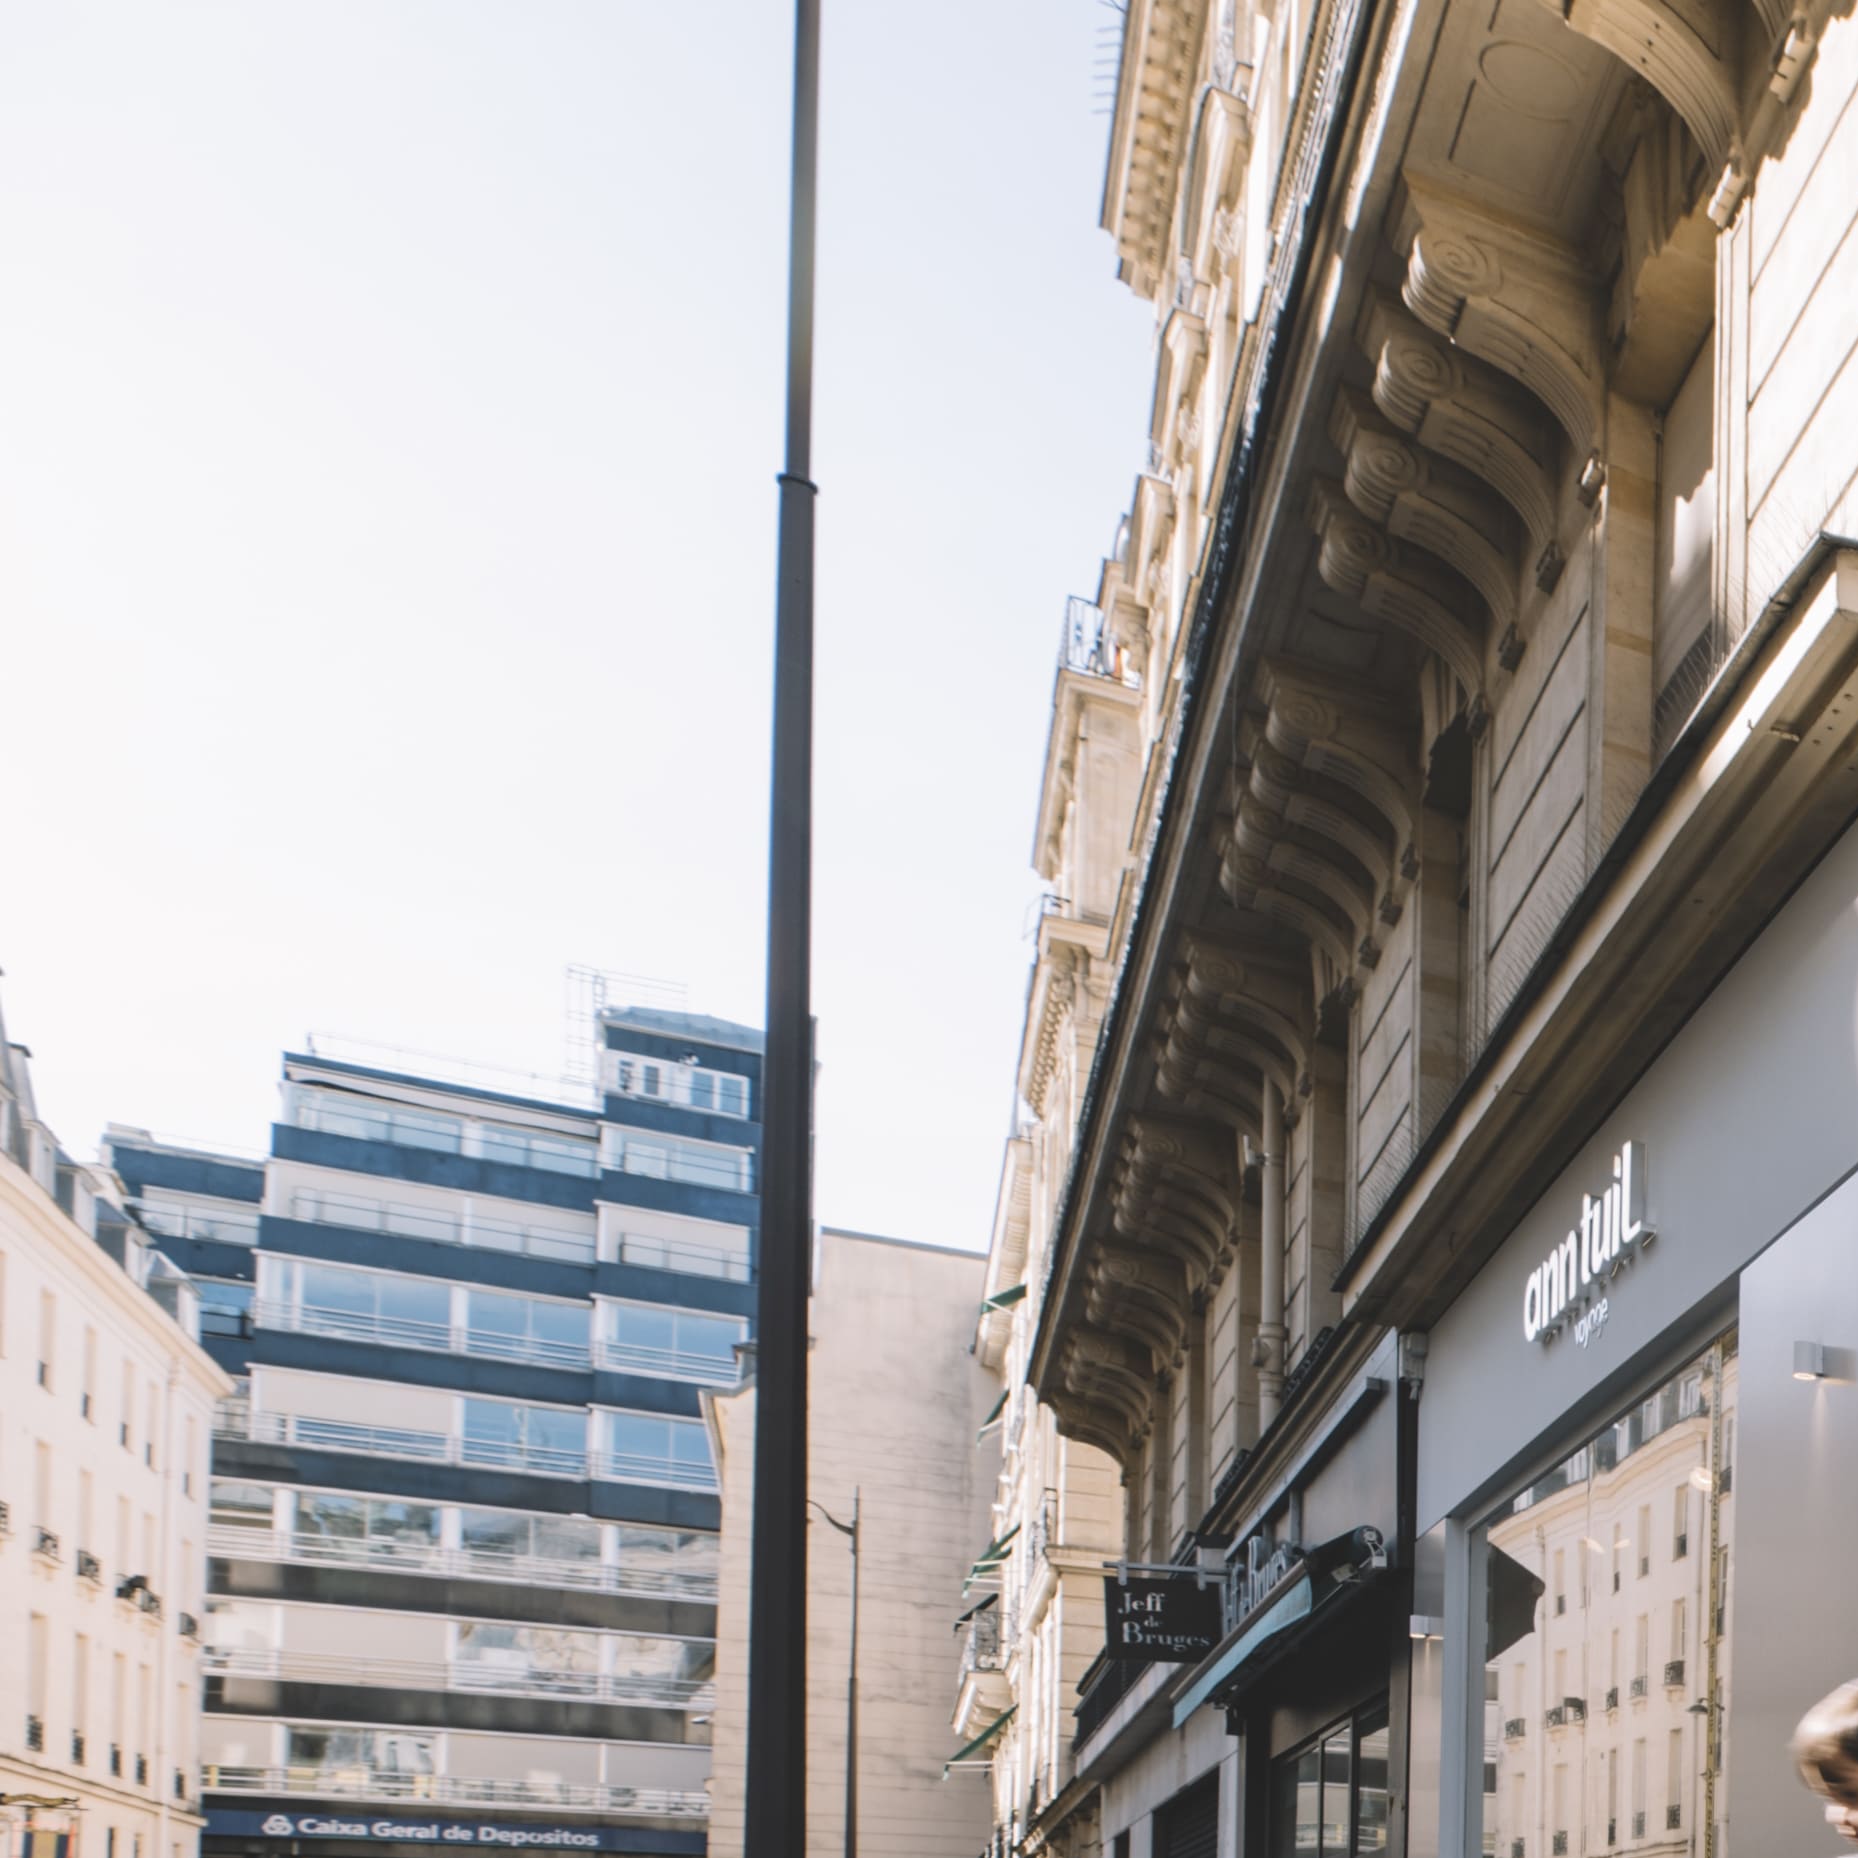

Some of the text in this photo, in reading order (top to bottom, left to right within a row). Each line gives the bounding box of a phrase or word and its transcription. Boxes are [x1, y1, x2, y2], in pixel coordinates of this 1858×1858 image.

[1524, 1140, 1645, 1342] ann tuil
[1574, 1297, 1608, 1348] voyage
[1117, 1592, 1165, 1614] Jeff
[1122, 1621, 1210, 1651] Bruges
[1144, 1616, 1163, 1627] de
[298, 1818, 599, 1847] Caixa Geral de Depositos
